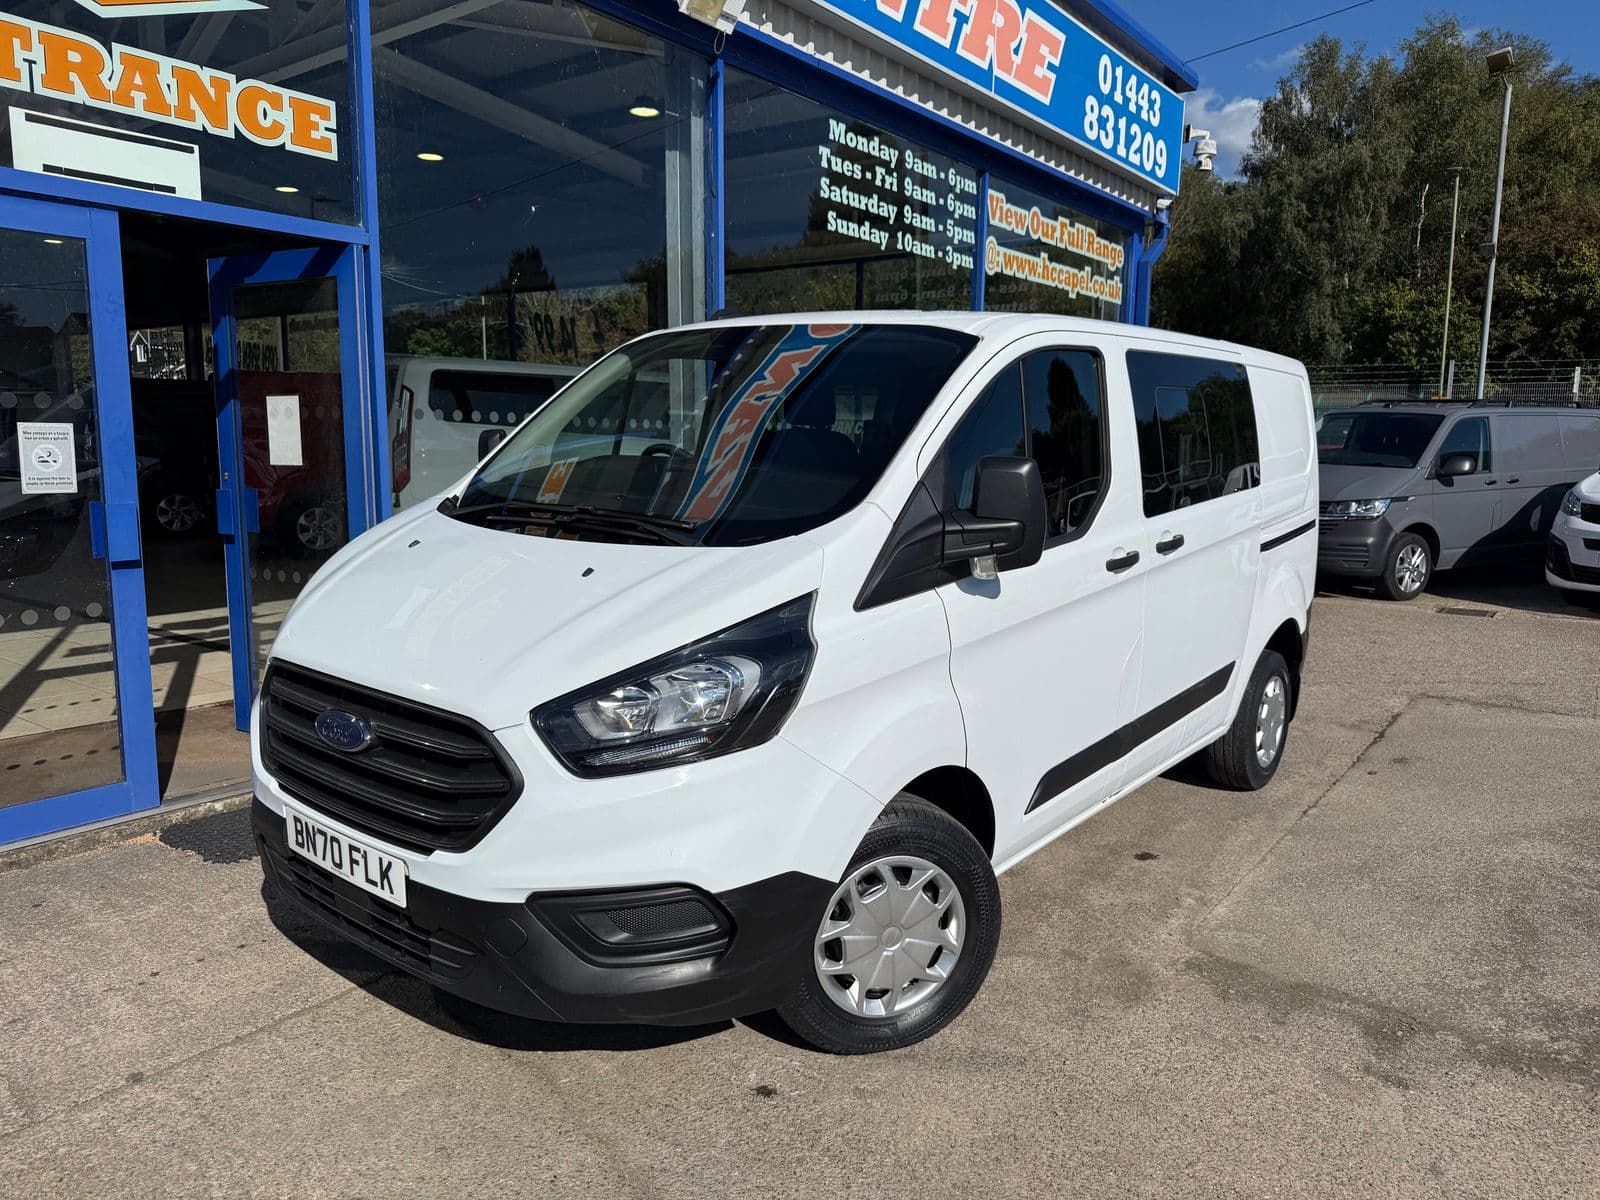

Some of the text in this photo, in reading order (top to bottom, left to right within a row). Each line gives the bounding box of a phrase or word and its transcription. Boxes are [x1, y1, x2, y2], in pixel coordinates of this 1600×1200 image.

[1098, 54, 1161, 127] 01443
[829, 118, 899, 169] Monday
[904, 150, 937, 179] 9am
[948, 168, 977, 195] 6pm
[1083, 95, 1167, 178] 831209
[819, 145, 862, 180] Tues
[875, 166, 898, 192] Fri
[904, 177, 936, 205] 9am
[947, 193, 976, 220] 6pm
[820, 176, 898, 225] Saturday
[904, 205, 935, 232] 9am
[946, 220, 975, 244] 5pm
[827, 210, 889, 250] Sunday
[897, 231, 935, 259] 10am
[945, 246, 974, 270] 3pm
[988, 190, 1123, 270] View Our Full Range
[1001, 248, 1121, 302] www.hccapel.co.uk
[292, 814, 395, 896] BN70 FLK
